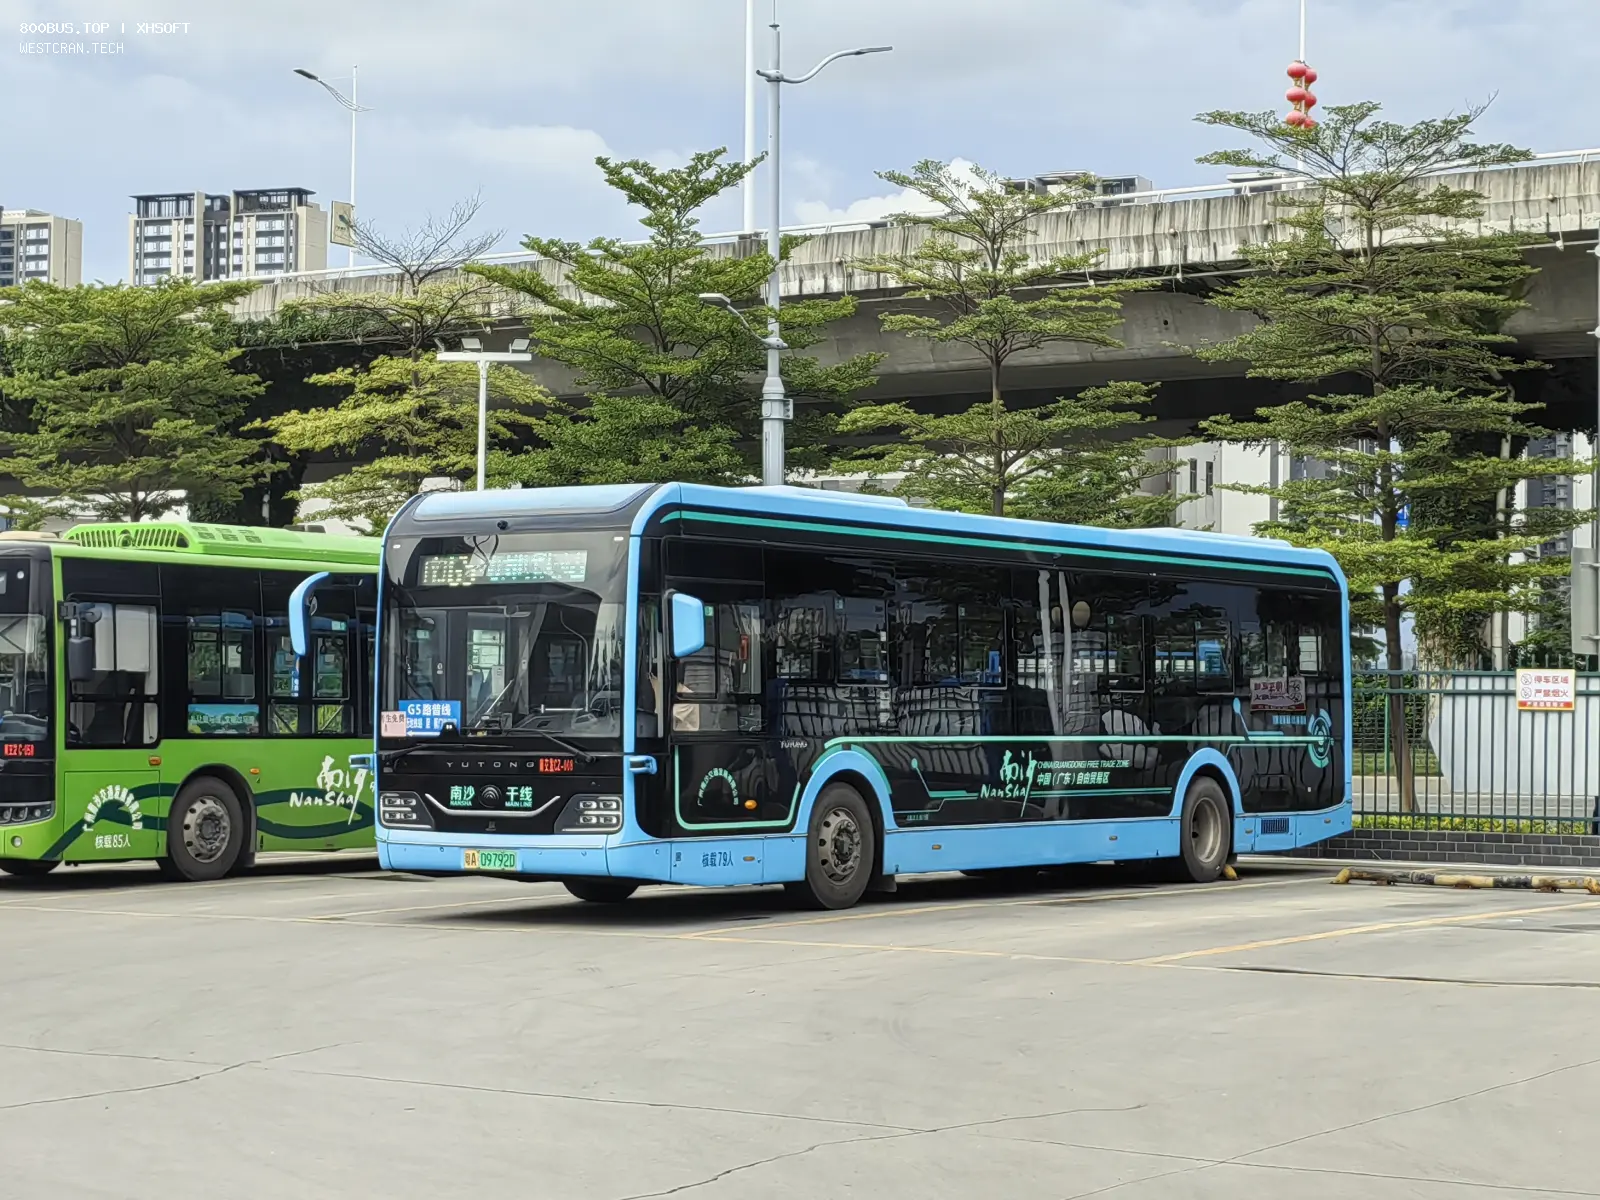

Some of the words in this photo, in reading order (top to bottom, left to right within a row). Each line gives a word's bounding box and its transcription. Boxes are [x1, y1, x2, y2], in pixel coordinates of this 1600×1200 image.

[289, 790, 354, 808] NanSha
[450, 785, 476, 801] 南沙
[505, 786, 533, 802] 干线
[980, 783, 1026, 799] NanSha
